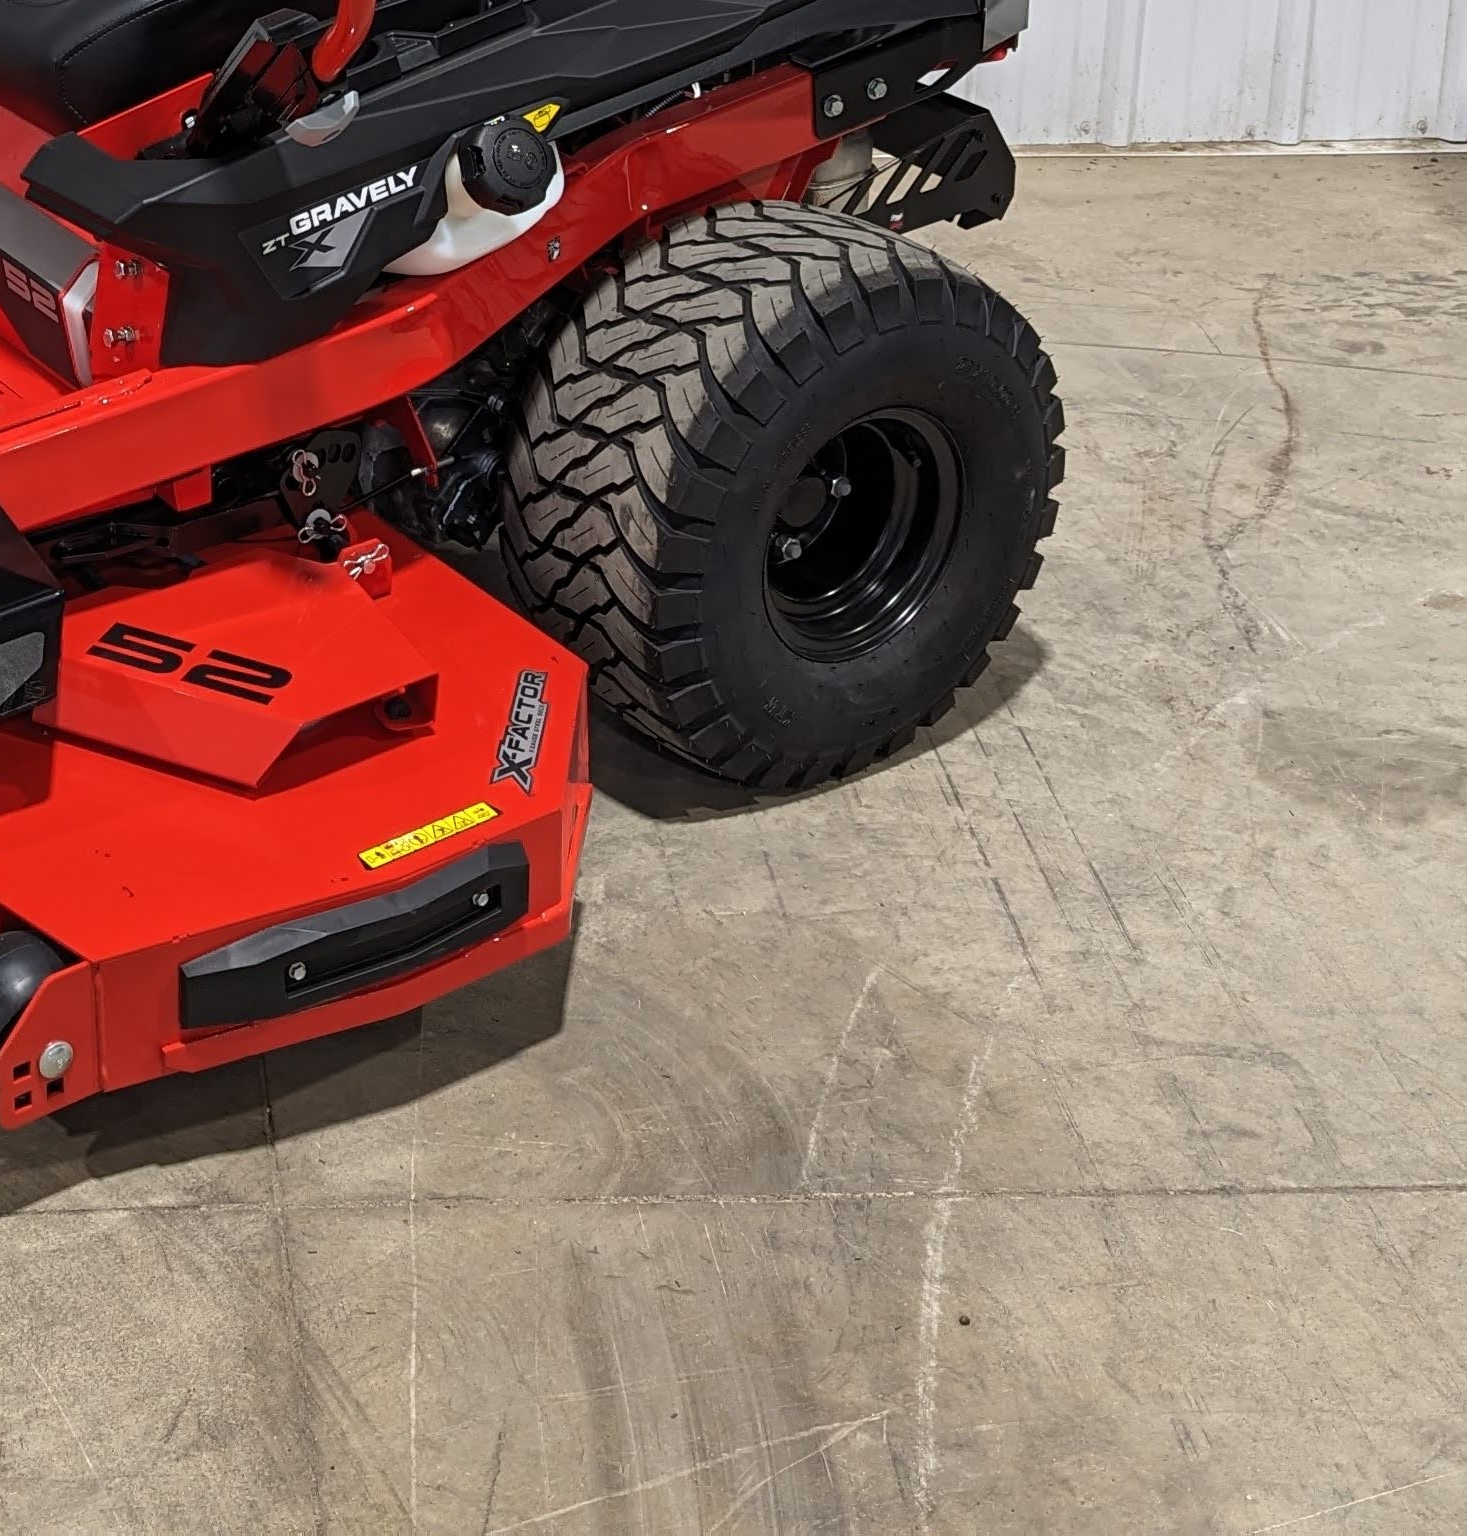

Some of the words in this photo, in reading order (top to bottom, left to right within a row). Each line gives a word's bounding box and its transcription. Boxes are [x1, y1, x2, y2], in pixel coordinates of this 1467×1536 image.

[288, 165, 418, 236] GRAVELY
[261, 232, 290, 256] ZT
[2, 258, 59, 324] 52
[84, 621, 294, 706] 52
[495, 671, 545, 787] X-FACTOR
